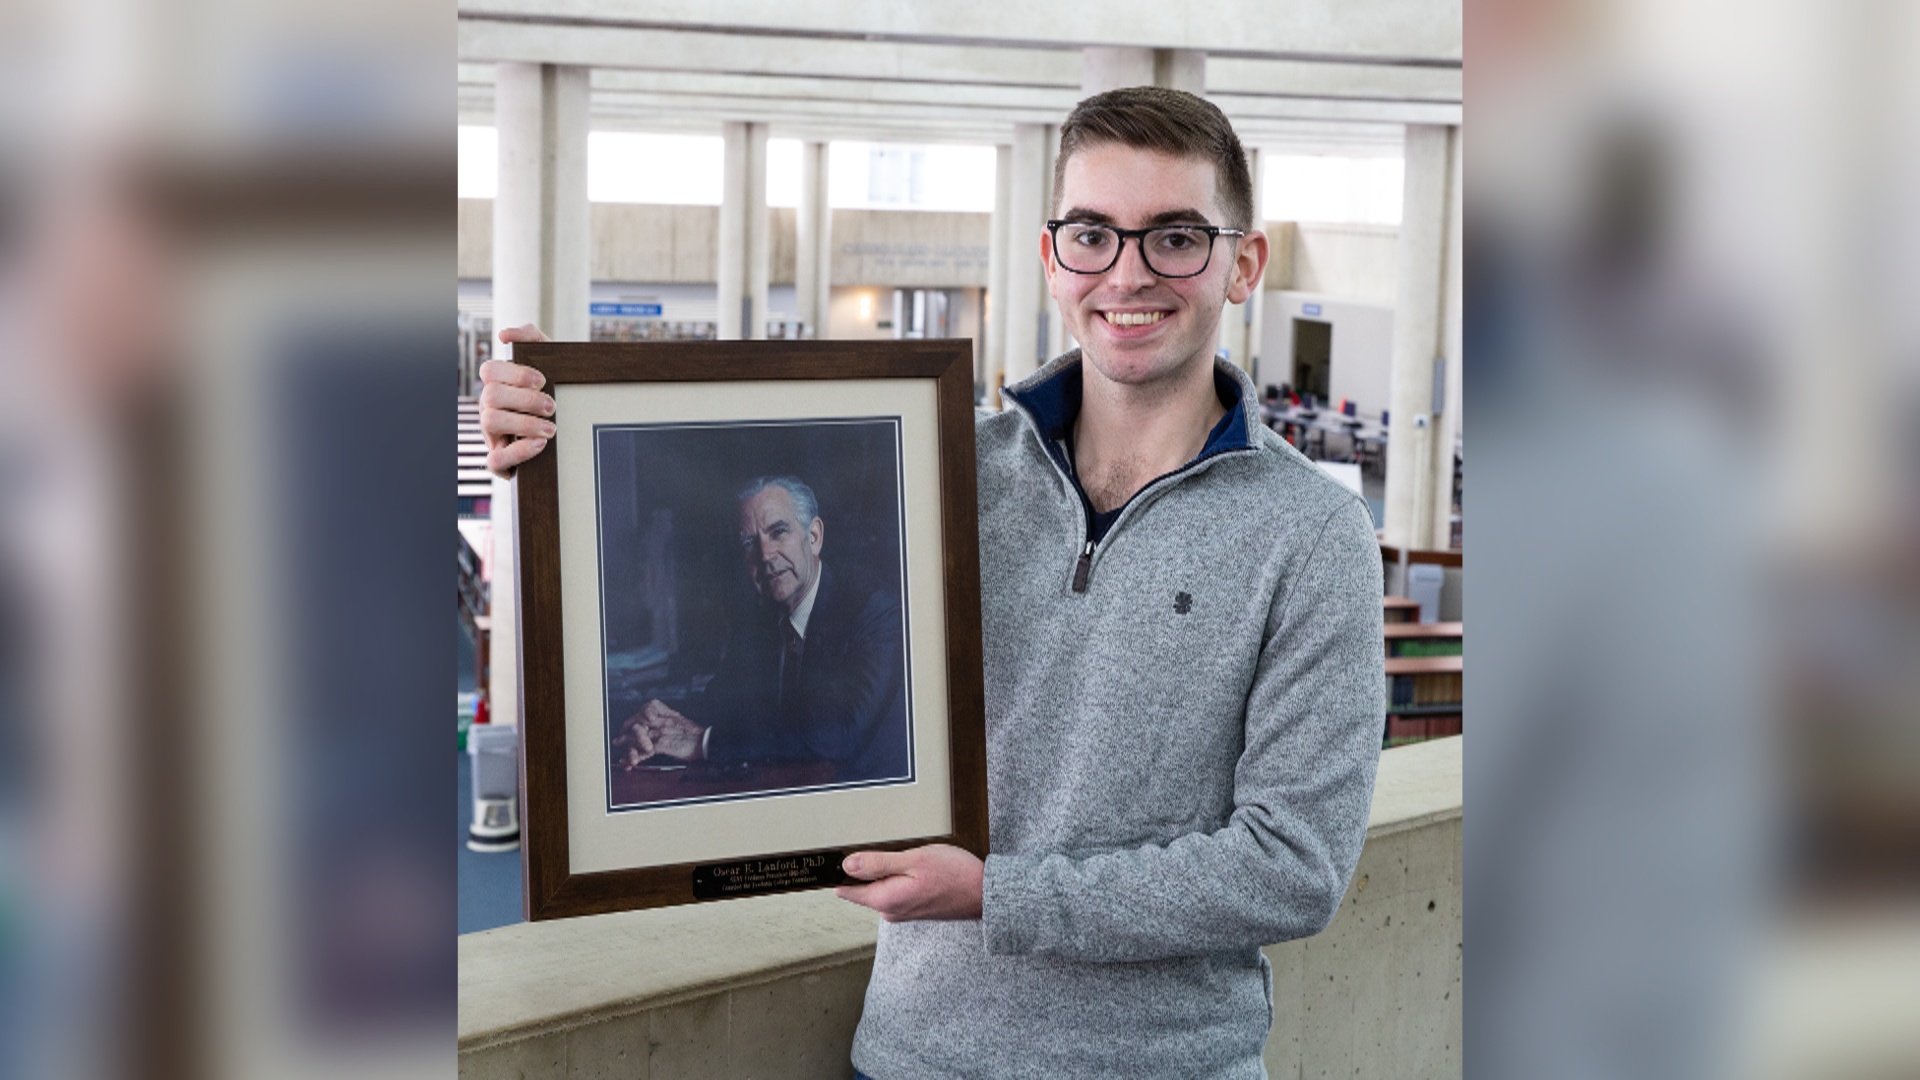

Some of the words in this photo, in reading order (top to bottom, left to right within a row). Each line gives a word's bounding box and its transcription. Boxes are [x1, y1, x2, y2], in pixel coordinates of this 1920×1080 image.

[713, 866, 740, 877] Oscar
[744, 863, 754, 873] E.
[758, 858, 799, 873] Lanford,
[803, 856, 825, 867] Ph.D
